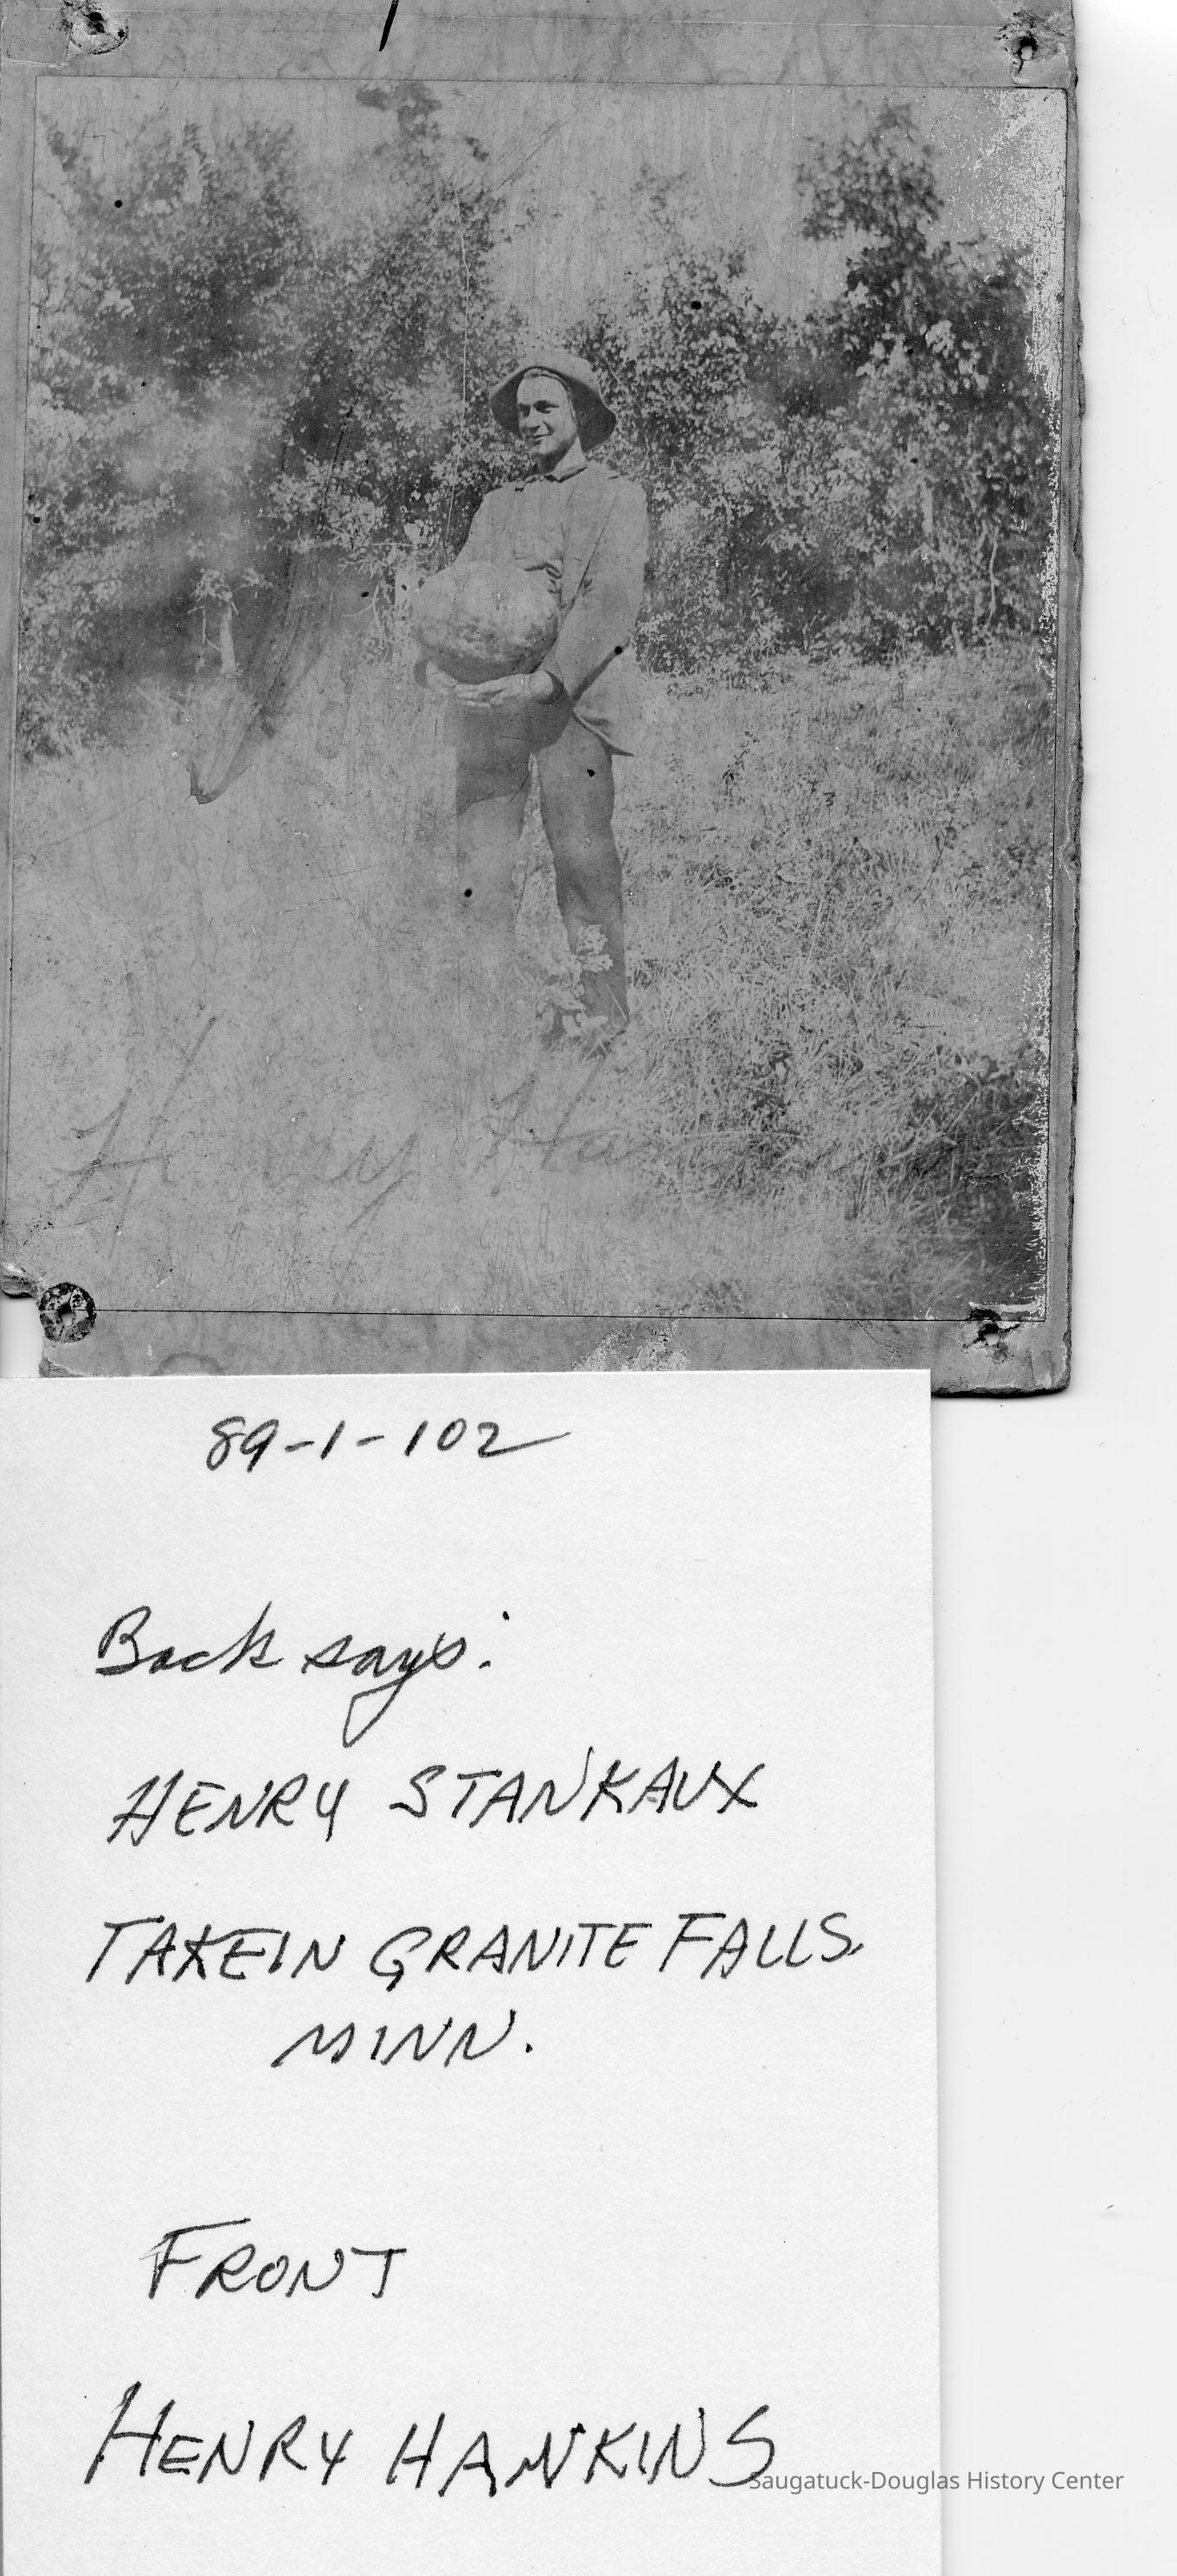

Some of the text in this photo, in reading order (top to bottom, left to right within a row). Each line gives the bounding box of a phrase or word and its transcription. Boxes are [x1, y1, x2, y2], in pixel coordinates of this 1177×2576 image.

[206, 1414, 570, 1473] 89-1-102
[94, 1600, 285, 1677] Back
[106, 1768, 350, 1846] HENRY
[369, 1922, 653, 1993] GRANITE
[269, 2008, 534, 2068] MINN.
[140, 2216, 407, 2299] FRONT
[84, 2380, 775, 2498] HENRY HANKINS
